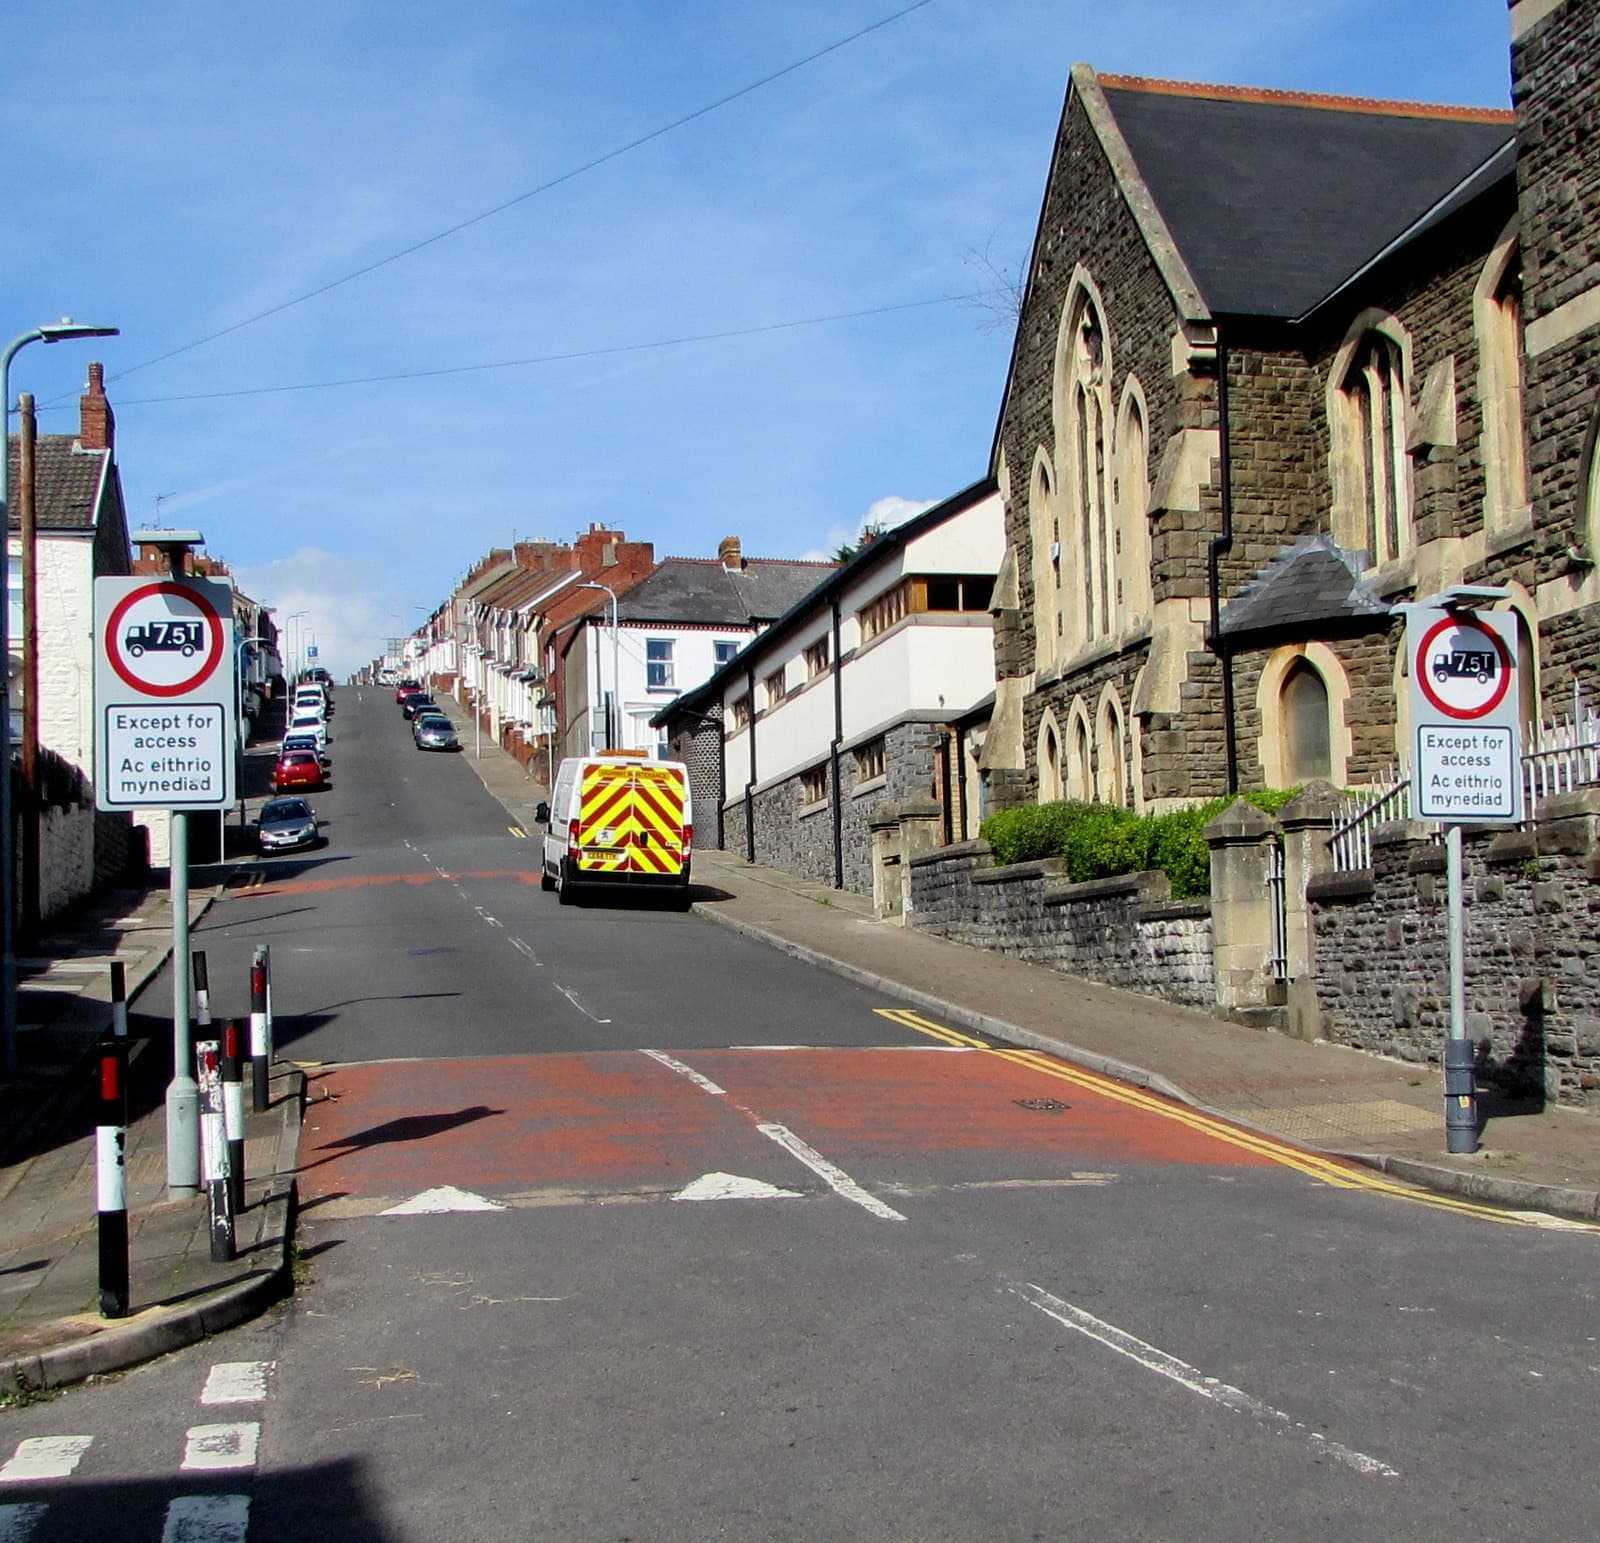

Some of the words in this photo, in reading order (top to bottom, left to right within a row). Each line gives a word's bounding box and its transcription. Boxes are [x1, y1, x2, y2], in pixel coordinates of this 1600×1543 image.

[153, 623, 199, 645] 7.5T
[1454, 652, 1491, 673] 7.5T
[116, 715, 181, 732] Except
[188, 714, 213, 729] for
[135, 735, 197, 749] access
[1427, 735, 1478, 751] Except
[1483, 735, 1504, 749] for
[120, 758, 144, 773] Ac
[151, 757, 212, 773] eithrio
[1441, 754, 1491, 767] access
[121, 776, 212, 794] mynediad
[1431, 774, 1450, 788] Ac
[1454, 774, 1503, 789] eithrio
[1431, 792, 1503, 808] mynediad
